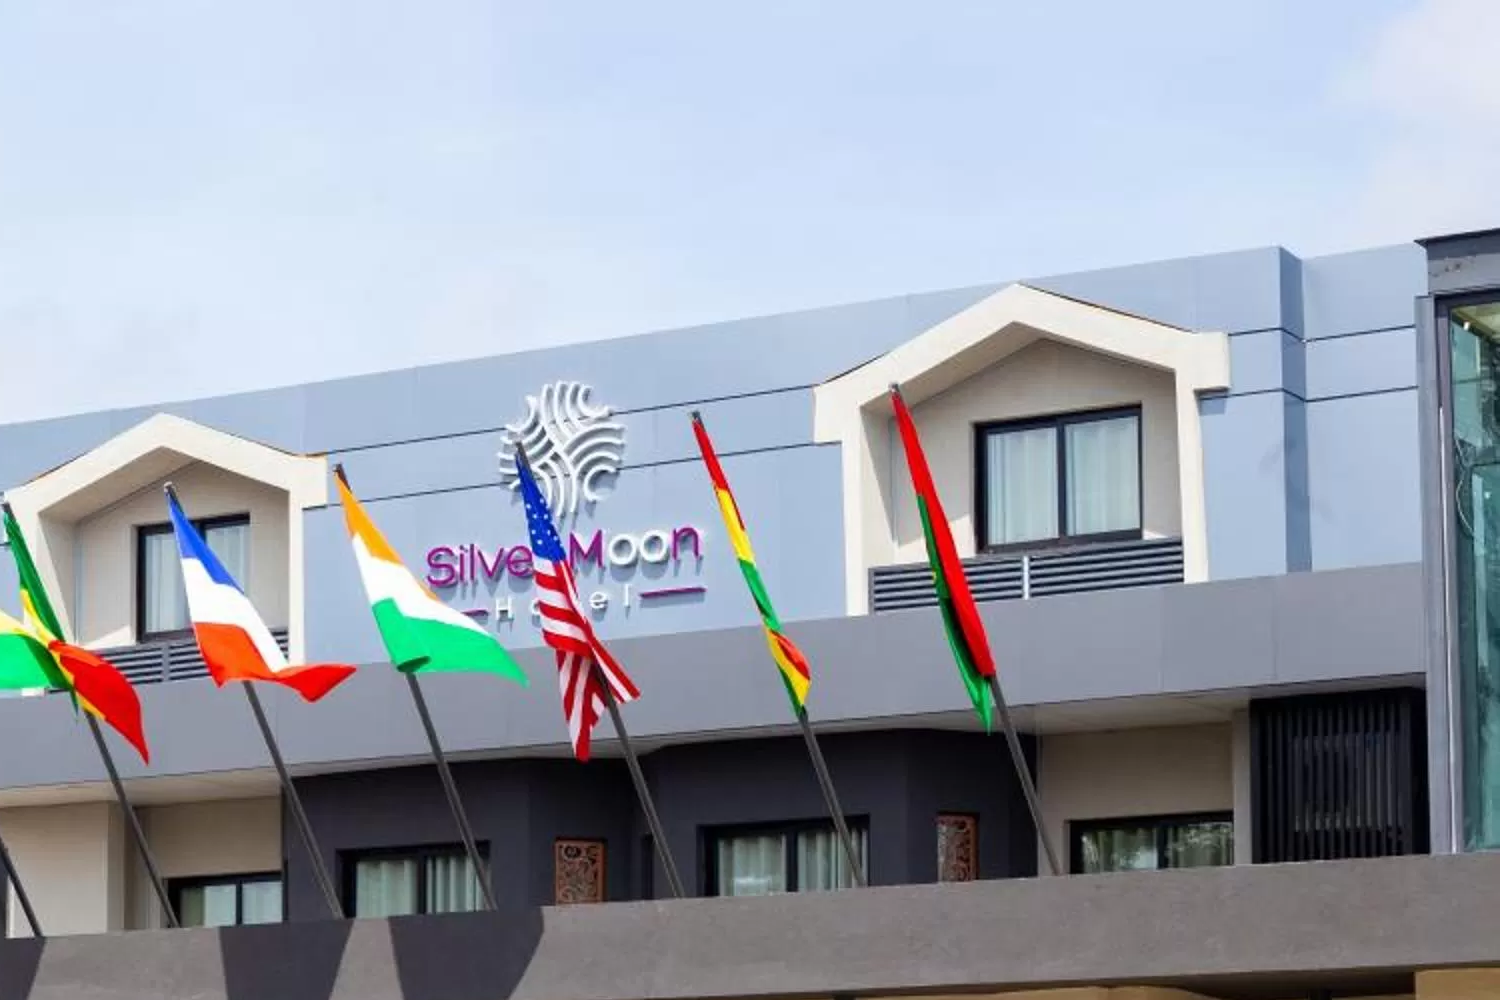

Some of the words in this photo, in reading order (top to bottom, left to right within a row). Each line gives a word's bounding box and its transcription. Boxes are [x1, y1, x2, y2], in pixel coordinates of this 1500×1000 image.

[426, 543, 535, 587] Silve
[569, 524, 701, 569] Moon
[495, 583, 632, 621] Hel
